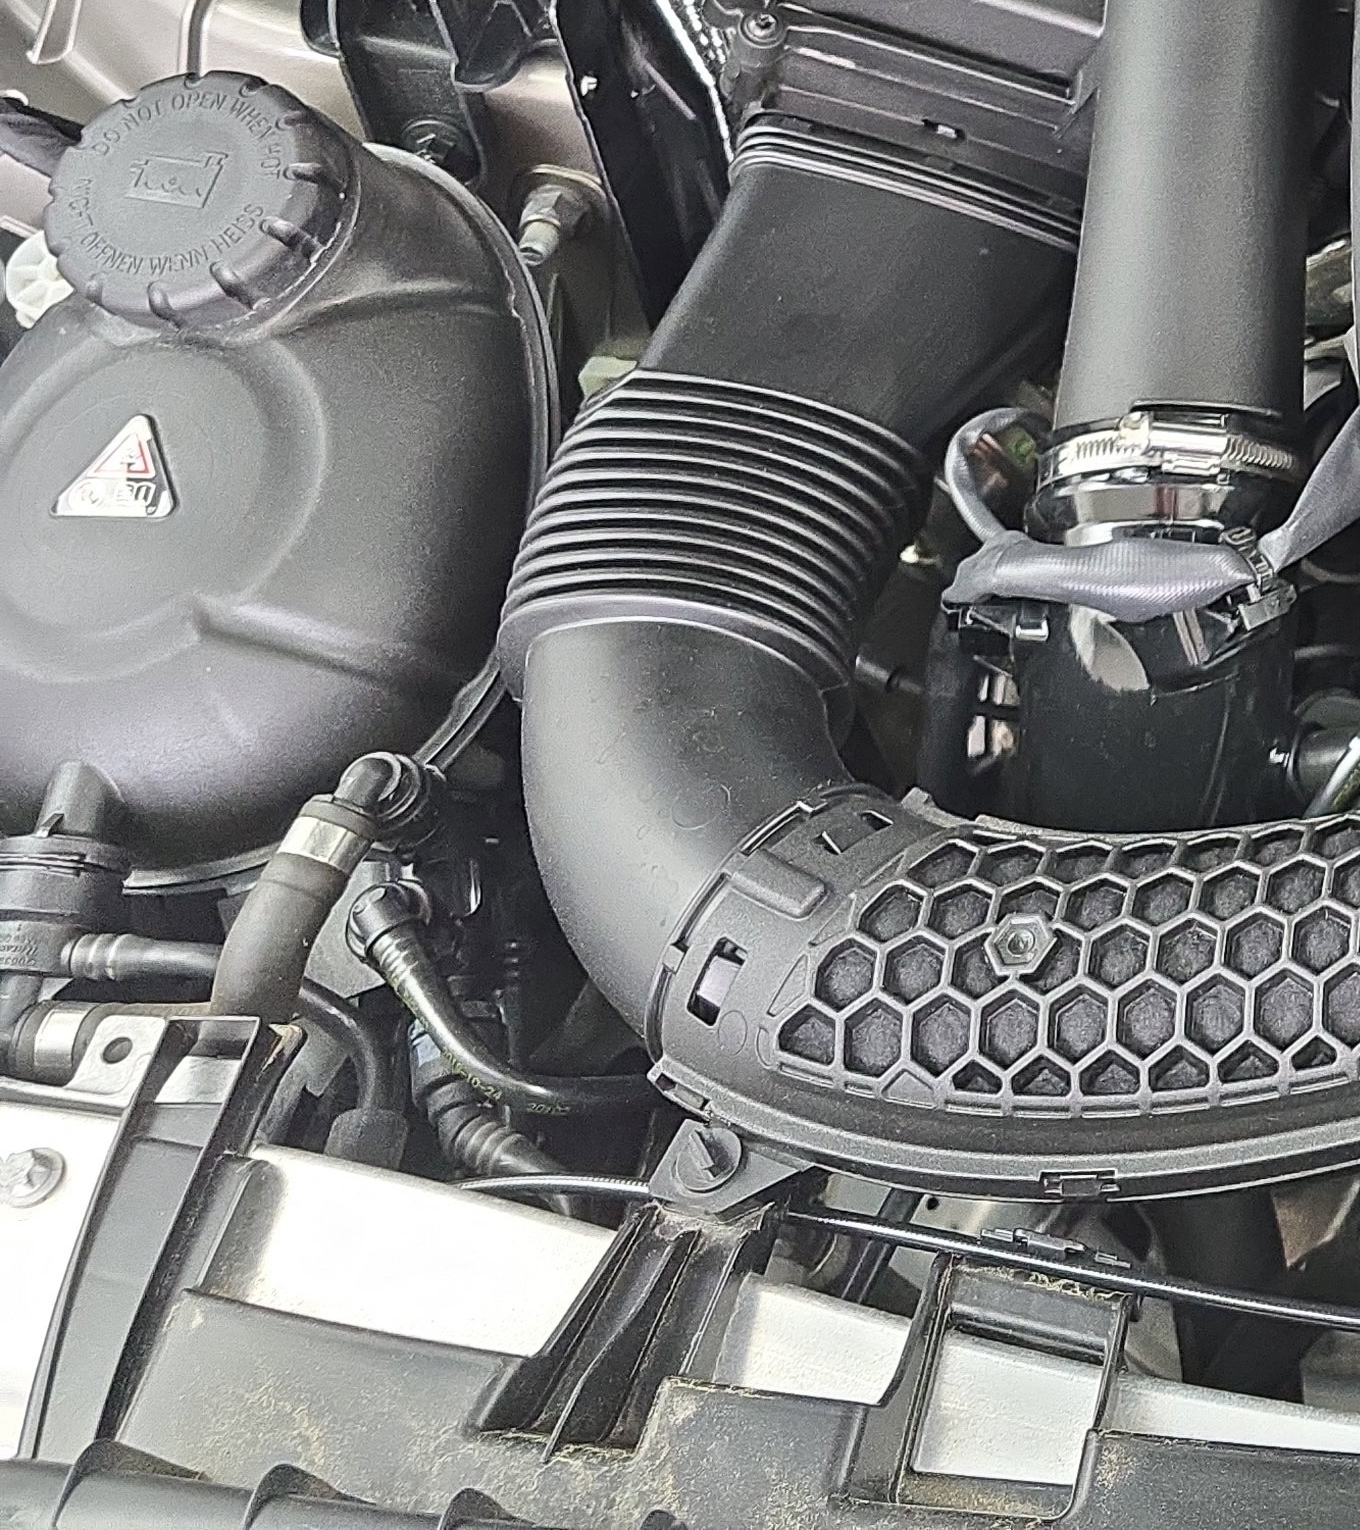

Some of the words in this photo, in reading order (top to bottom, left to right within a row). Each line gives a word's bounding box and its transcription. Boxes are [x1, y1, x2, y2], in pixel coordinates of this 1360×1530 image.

[92, 129, 121, 156] DO
[126, 101, 163, 133] NOT
[171, 92, 227, 111] OPEN
[231, 94, 273, 139] WHEN
[210, 204, 264, 254] HEISS
